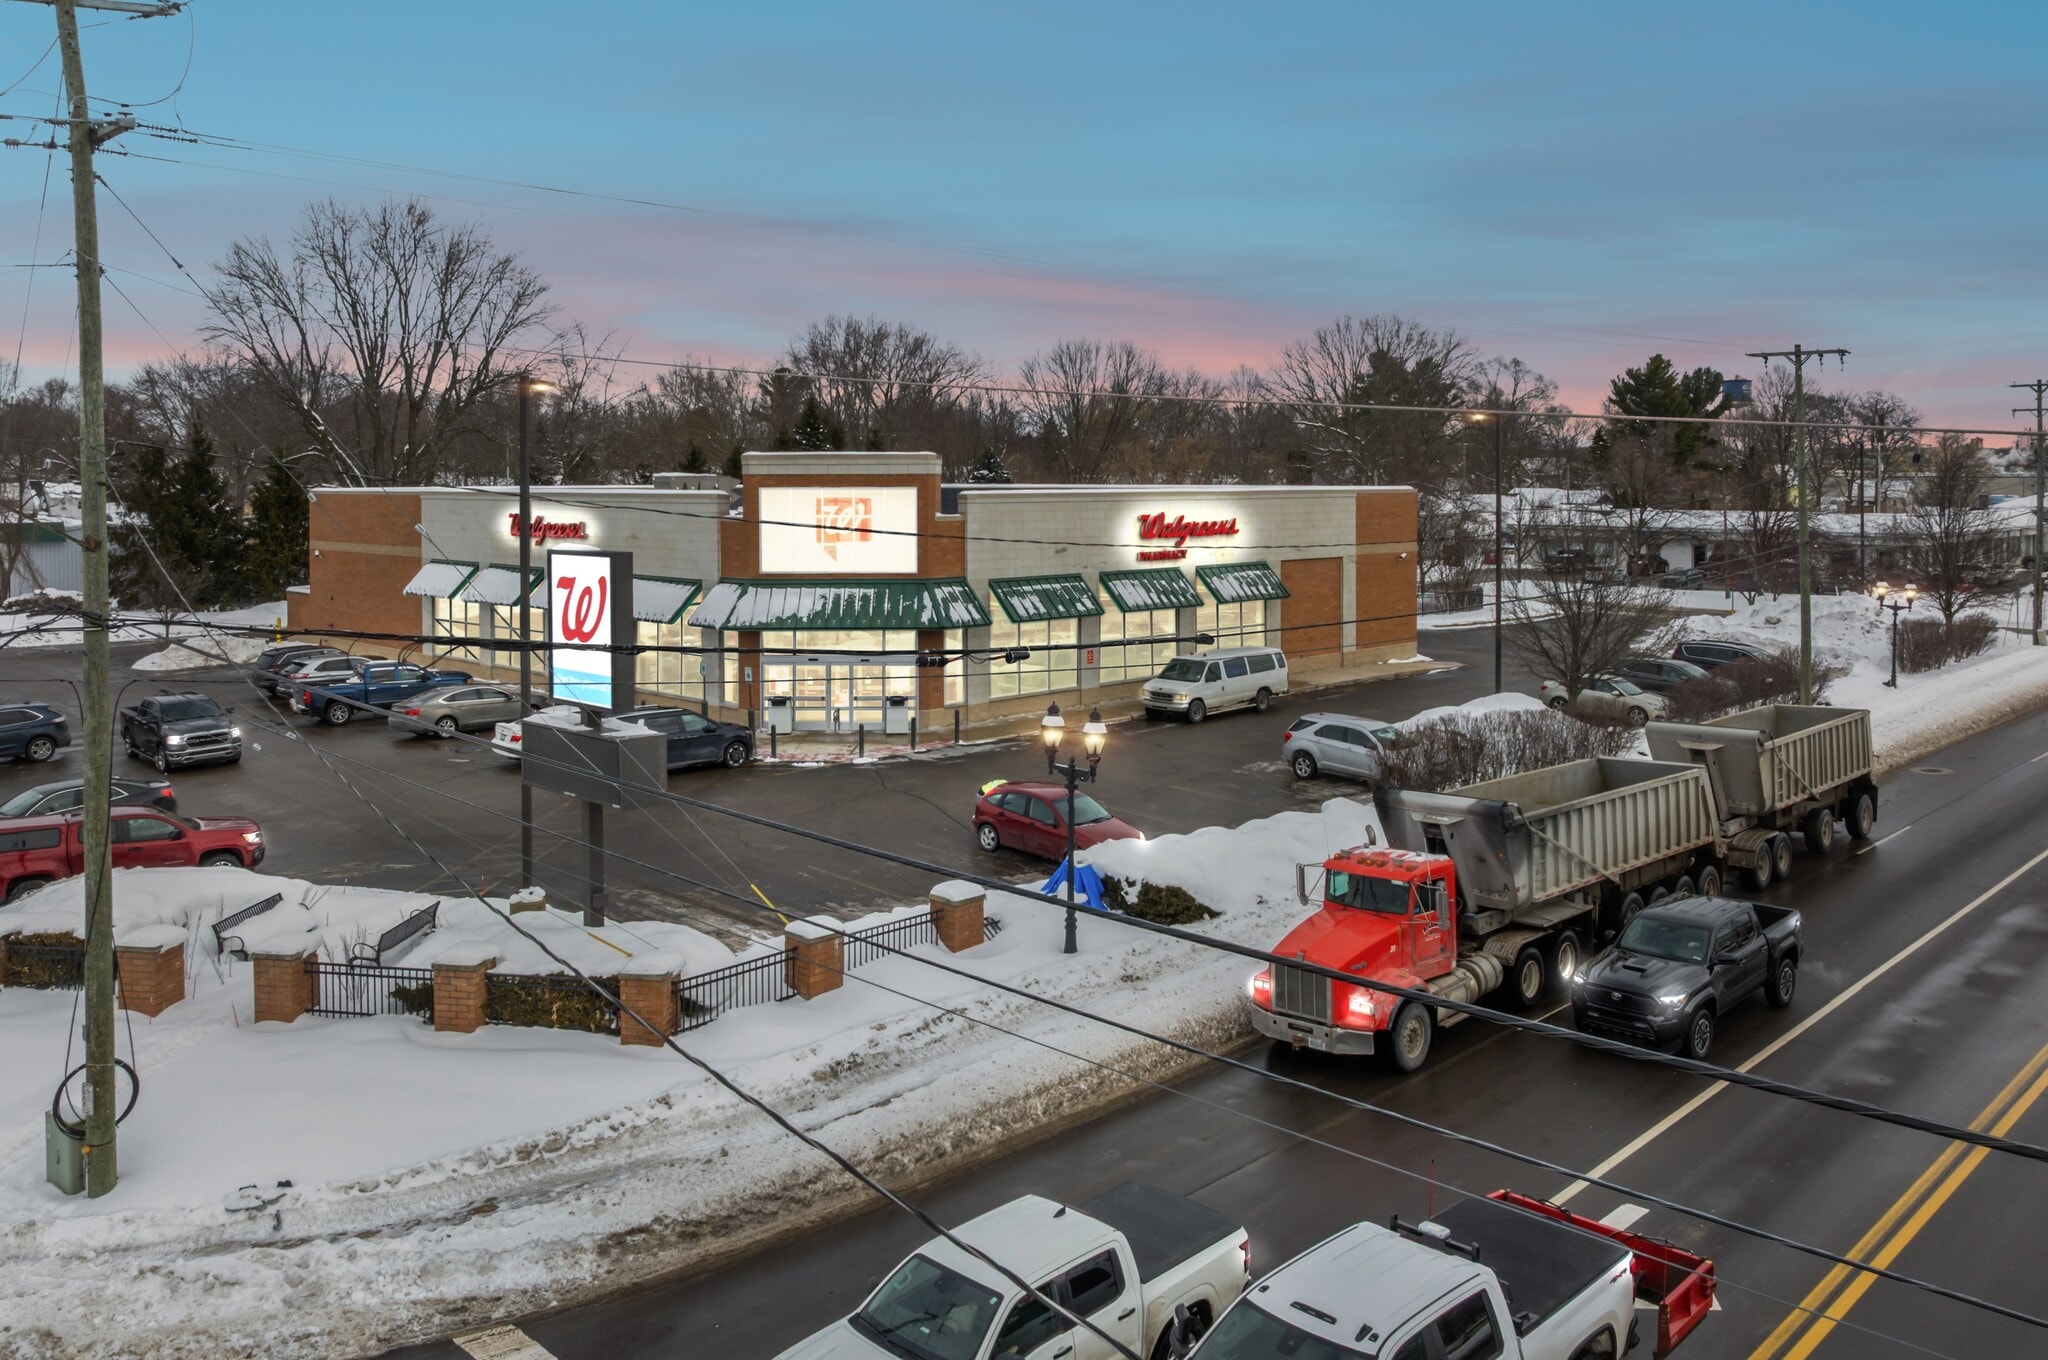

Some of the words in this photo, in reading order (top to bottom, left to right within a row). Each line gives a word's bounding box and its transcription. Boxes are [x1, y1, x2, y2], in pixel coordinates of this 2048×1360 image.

[1138, 512, 1239, 547] Walgreens
[1138, 549, 1187, 561] PHARMACY
[556, 575, 607, 643] W
